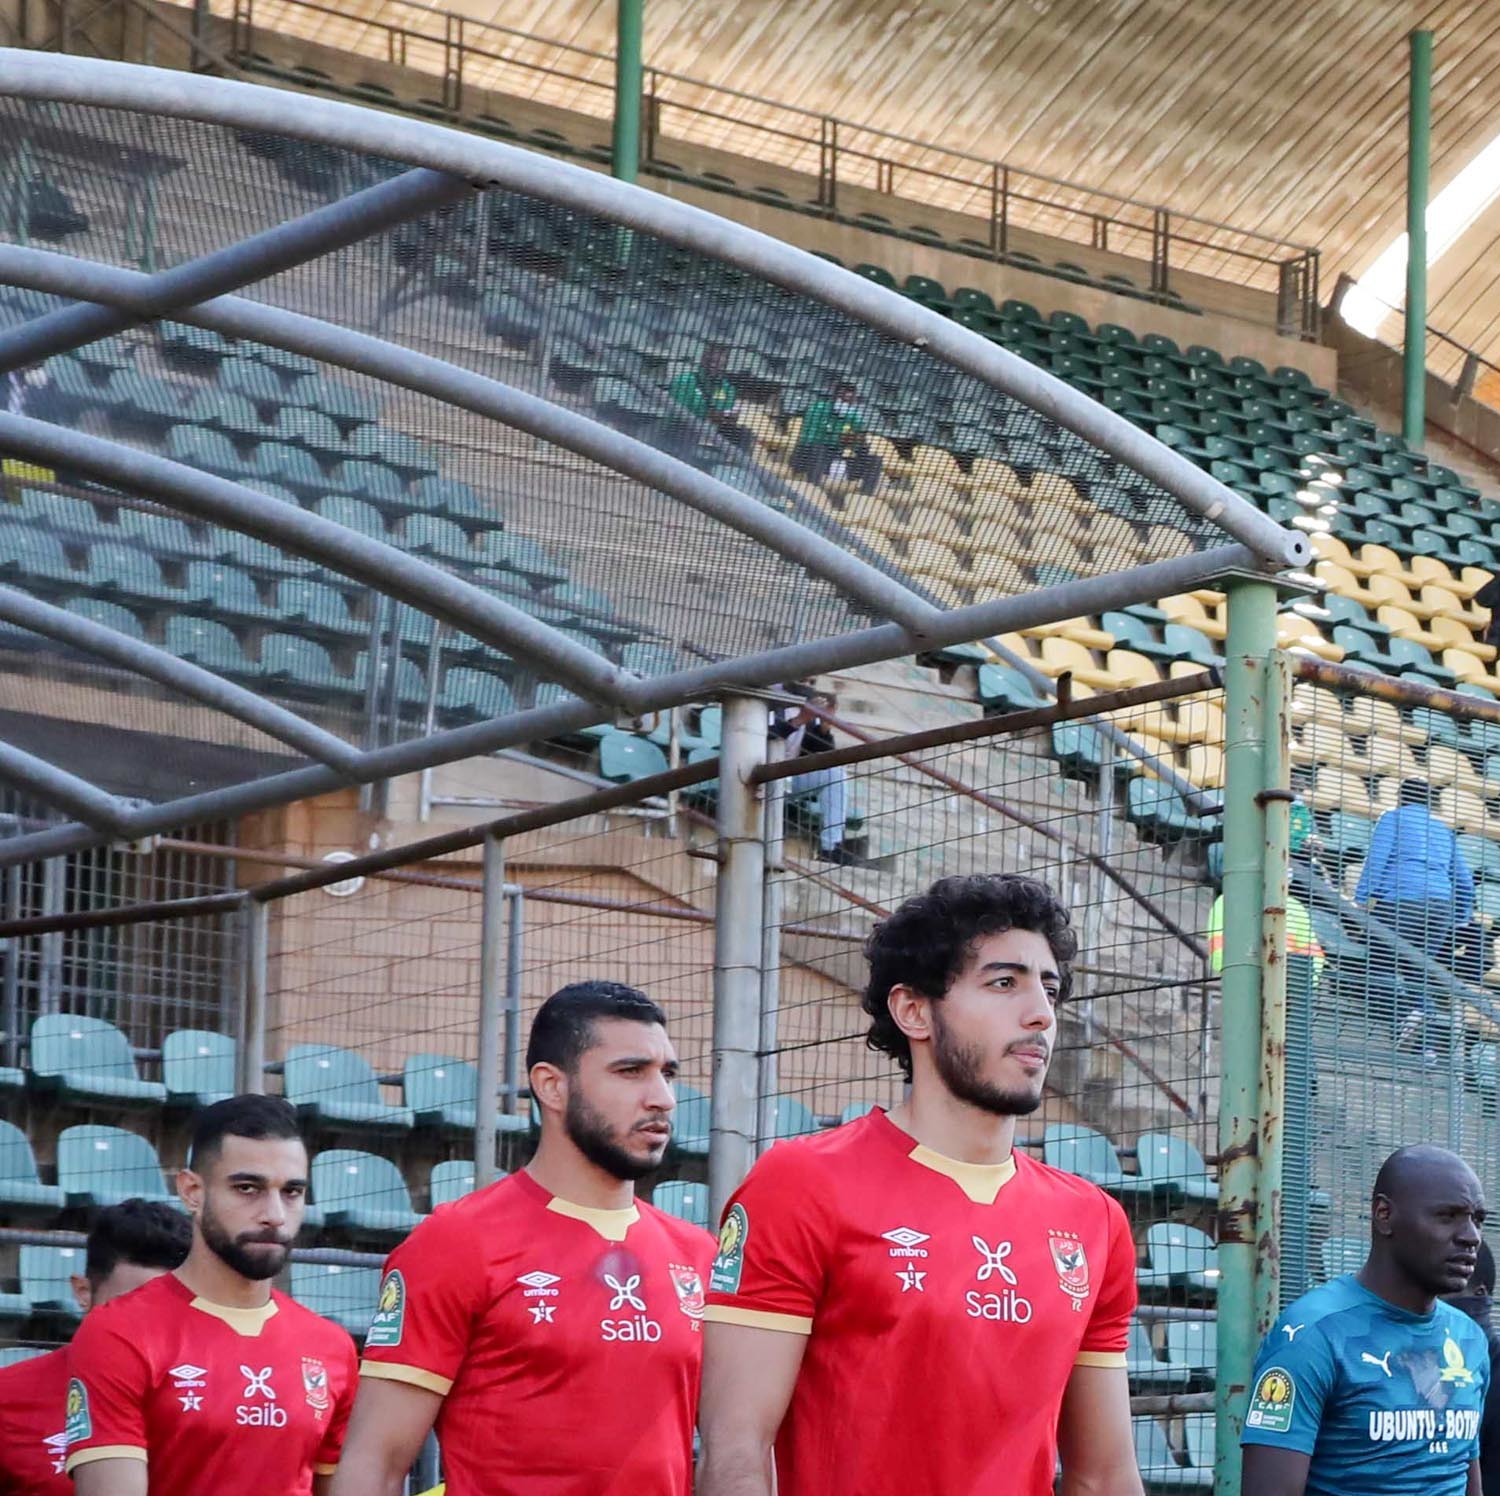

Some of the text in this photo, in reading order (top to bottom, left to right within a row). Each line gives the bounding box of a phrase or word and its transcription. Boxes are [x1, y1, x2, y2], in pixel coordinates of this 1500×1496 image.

[711, 1257, 737, 1269] AF
[889, 1246, 929, 1259] umbro
[523, 1288, 560, 1298] umbro
[965, 1289, 1033, 1325] saib
[600, 1315, 662, 1343] saib
[236, 1402, 288, 1428] saib
[1369, 1409, 1436, 1441] UBUNTU
[1445, 1409, 1480, 1440] BOTH
